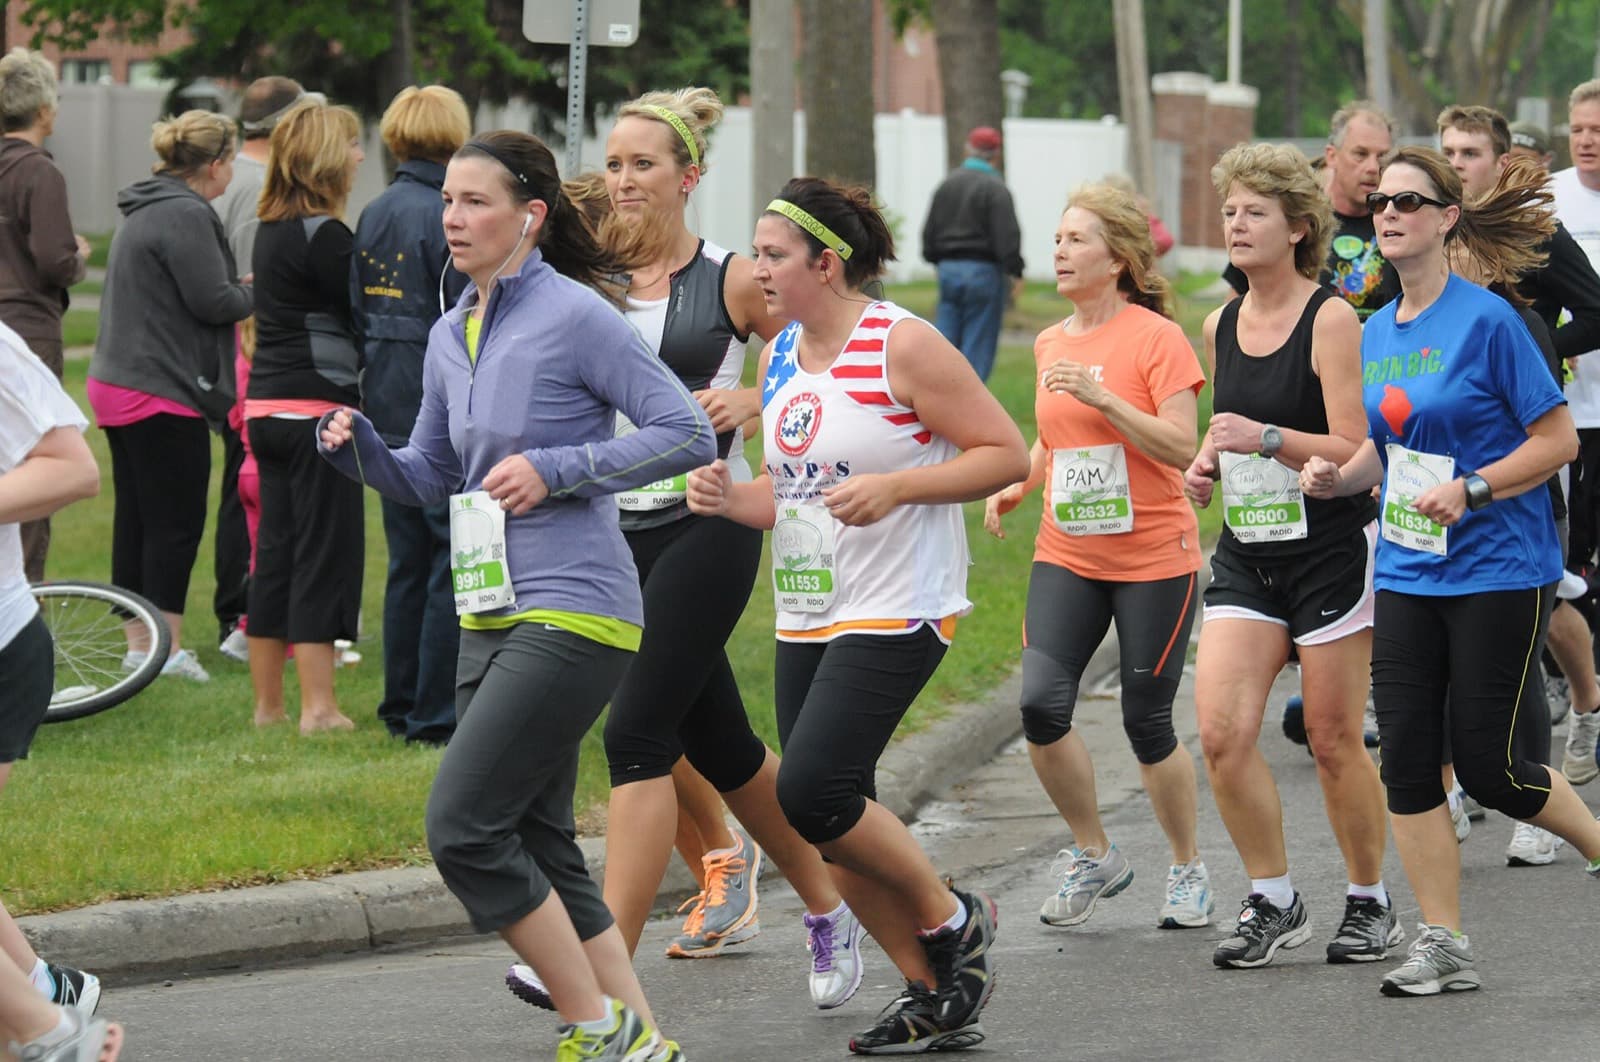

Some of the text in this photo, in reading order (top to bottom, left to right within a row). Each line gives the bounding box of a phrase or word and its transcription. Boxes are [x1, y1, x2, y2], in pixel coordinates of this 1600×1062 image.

[792, 209, 825, 237] FARGO
[1362, 355, 1406, 385] RUN
[1407, 452, 1420, 463] 10K
[1065, 467, 1104, 488] PAM
[620, 497, 678, 505] RADIO RADIO
[785, 508, 799, 518] 10K
[1067, 503, 1118, 519] 12632
[1238, 508, 1288, 525] 10600
[1100, 521, 1121, 530] RADIO
[1392, 509, 1433, 534] 11634
[1269, 527, 1293, 537] RADIO
[1415, 536, 1436, 547] RADIO
[782, 574, 820, 590] 11553
